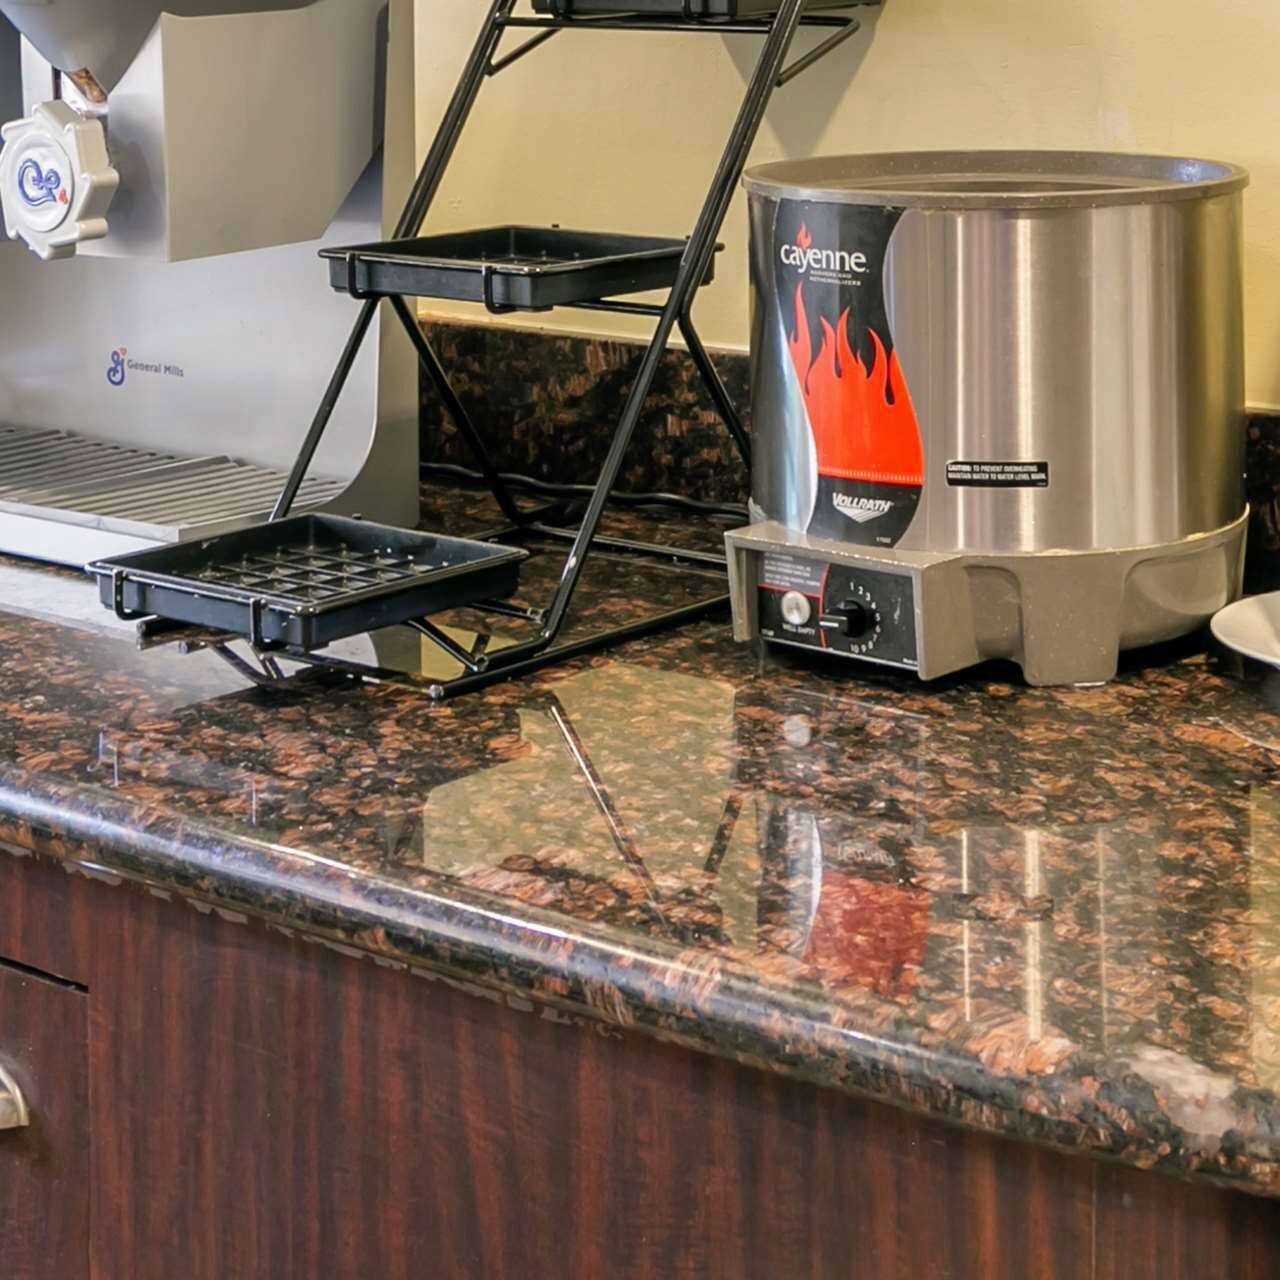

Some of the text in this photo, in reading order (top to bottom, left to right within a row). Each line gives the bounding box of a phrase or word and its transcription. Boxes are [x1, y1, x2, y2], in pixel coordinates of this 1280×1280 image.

[780, 243, 867, 273] cayenne
[127, 359, 184, 377] General Mills
[832, 492, 890, 512] VOLLRATH
[850, 581, 855, 591] 1
[858, 586, 864, 595] 2
[865, 592, 871, 601] 3
[871, 602, 877, 610] 4
[875, 613, 881, 622] 5
[875, 625, 881, 633] 6
[850, 644, 860, 654] 10
[861, 644, 867, 653] 9
